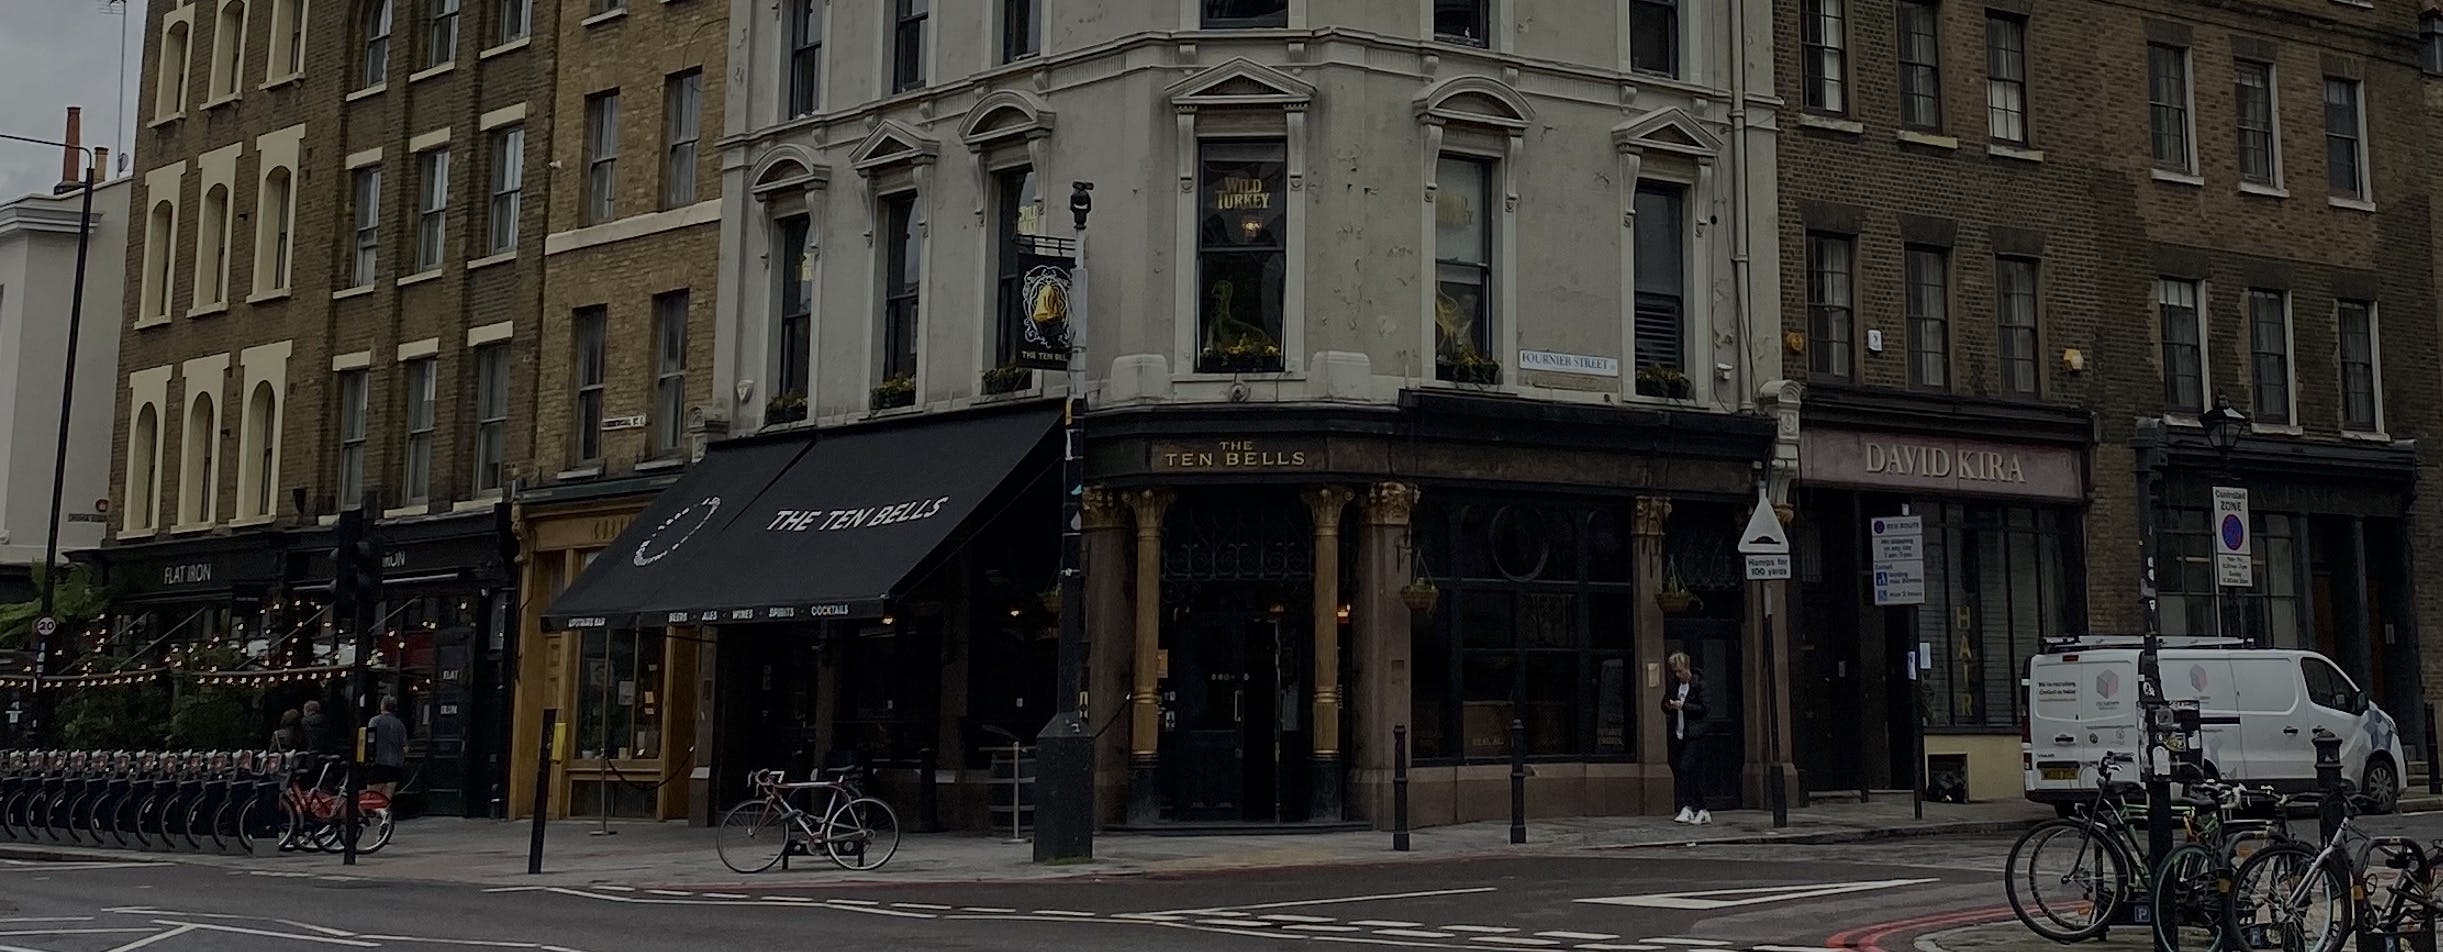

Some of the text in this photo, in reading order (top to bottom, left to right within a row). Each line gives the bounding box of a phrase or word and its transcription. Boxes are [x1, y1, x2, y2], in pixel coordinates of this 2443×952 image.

[1224, 176, 1264, 194] WILD
[1216, 189, 1270, 209] TURKEY
[1021, 350, 1037, 360] THE
[1039, 352, 1054, 361] TEN
[1521, 351, 1573, 366] FOURNIER
[1574, 357, 1608, 370] STREET
[1219, 440, 1254, 451] THE
[1165, 451, 1305, 467] TEN BELLS
[1866, 442, 2027, 483] DAVID KIRA
[2215, 489, 2247, 500] Controlled
[766, 496, 949, 532] THE TEN BELLS
[2221, 500, 2242, 512] ZONE
[164, 563, 212, 585] FLAT IRON
[701, 610, 718, 621] ALES
[811, 603, 849, 617] COCKTAILS
[40, 621, 55, 631] 20
[1956, 605, 1974, 718] HAIR
